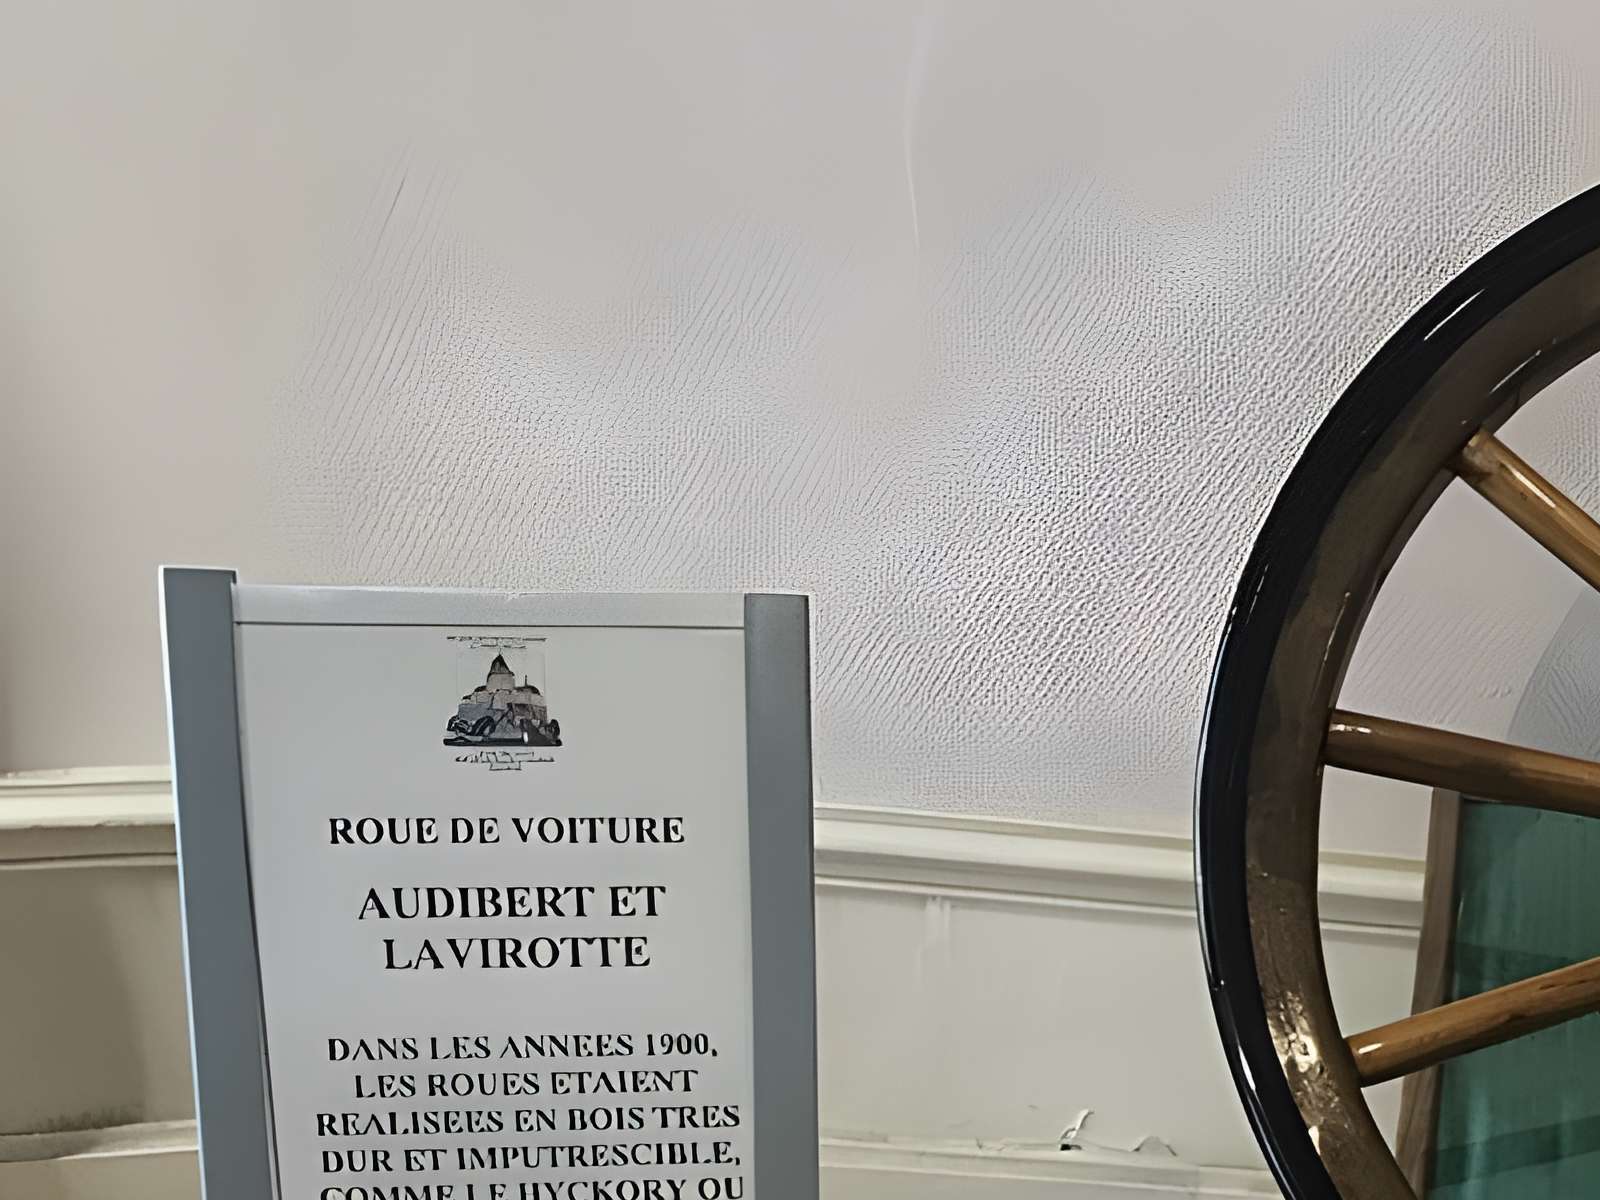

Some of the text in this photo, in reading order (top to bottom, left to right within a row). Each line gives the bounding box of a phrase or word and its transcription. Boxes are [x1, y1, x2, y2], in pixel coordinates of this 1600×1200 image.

[328, 816, 685, 845] ROUE DE VOITURE
[358, 885, 667, 920] AUDIBERT ET
[382, 936, 651, 970] LAVIROTTE
[327, 1033, 718, 1062] DANS LES ANNEES 1900,
[354, 1069, 699, 1099] LES ROUES ETAIENT
[316, 1104, 740, 1137] REALISEES EN BOIS TRES
[322, 1141, 741, 1173] DUR ET IMPUTRESCIBLE,
[697, 1176, 744, 1200] OU
